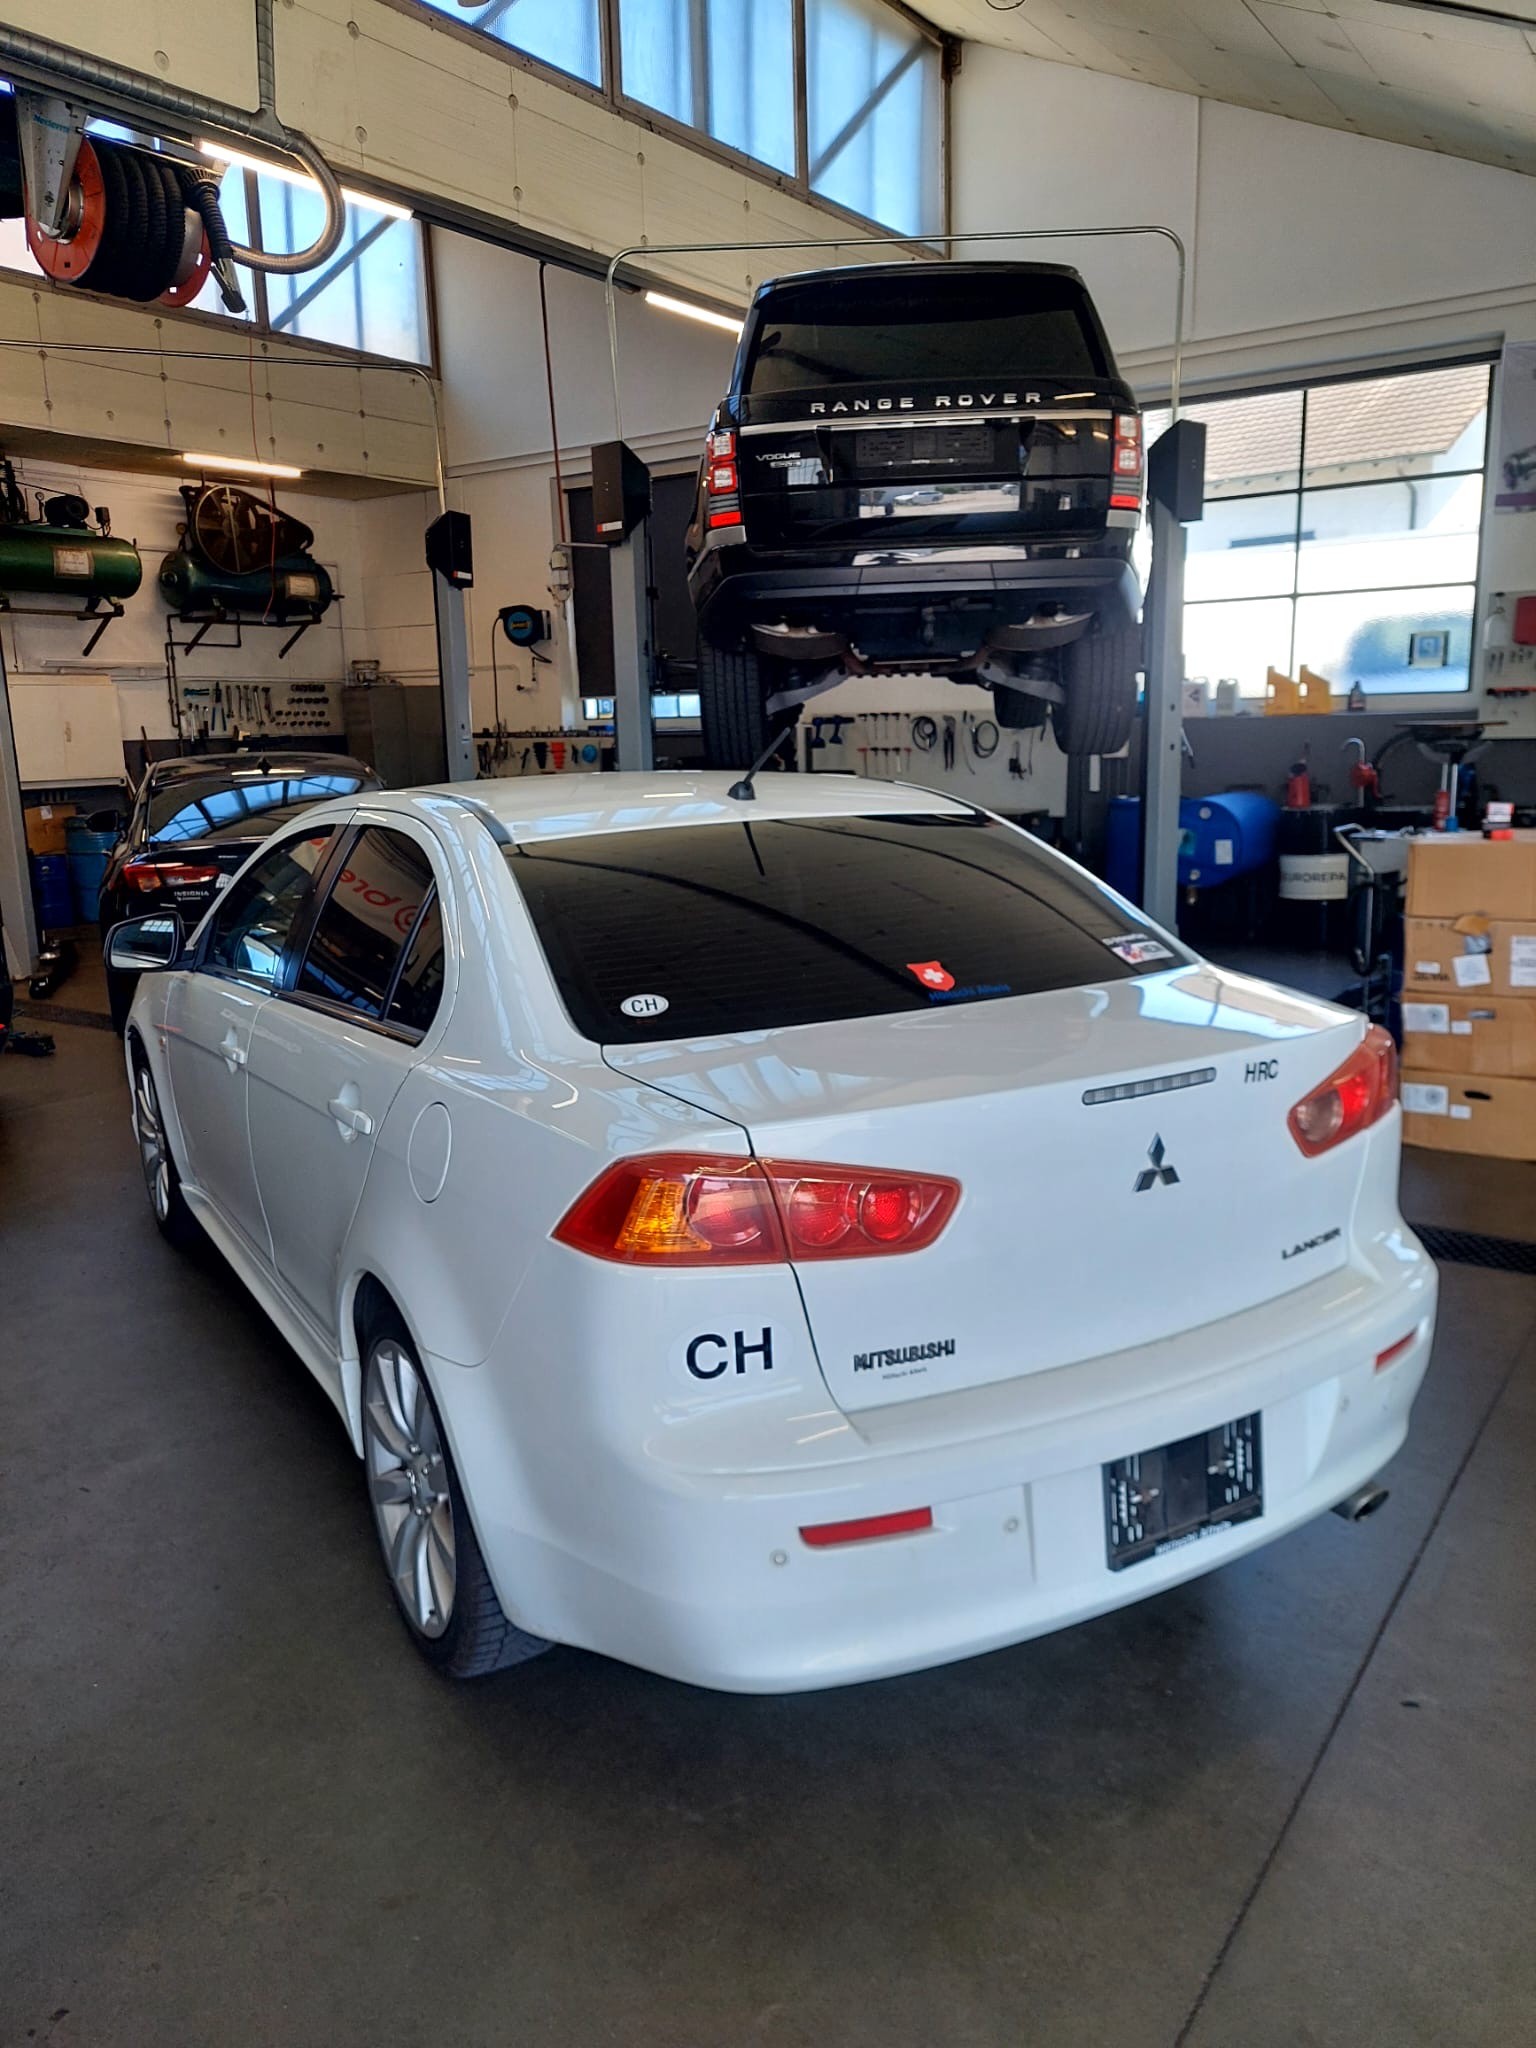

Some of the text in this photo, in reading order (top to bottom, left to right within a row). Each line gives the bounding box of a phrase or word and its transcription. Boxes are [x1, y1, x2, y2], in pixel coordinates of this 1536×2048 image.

[810, 392, 1041, 413] RANGE ROVER
[755, 451, 801, 461] VOGUE
[631, 997, 658, 1013] CH
[1244, 1059, 1279, 1083] HRC
[1281, 1227, 1341, 1260] LANCER
[686, 1326, 773, 1380] CH
[853, 1338, 955, 1372] MITSUBISHI
